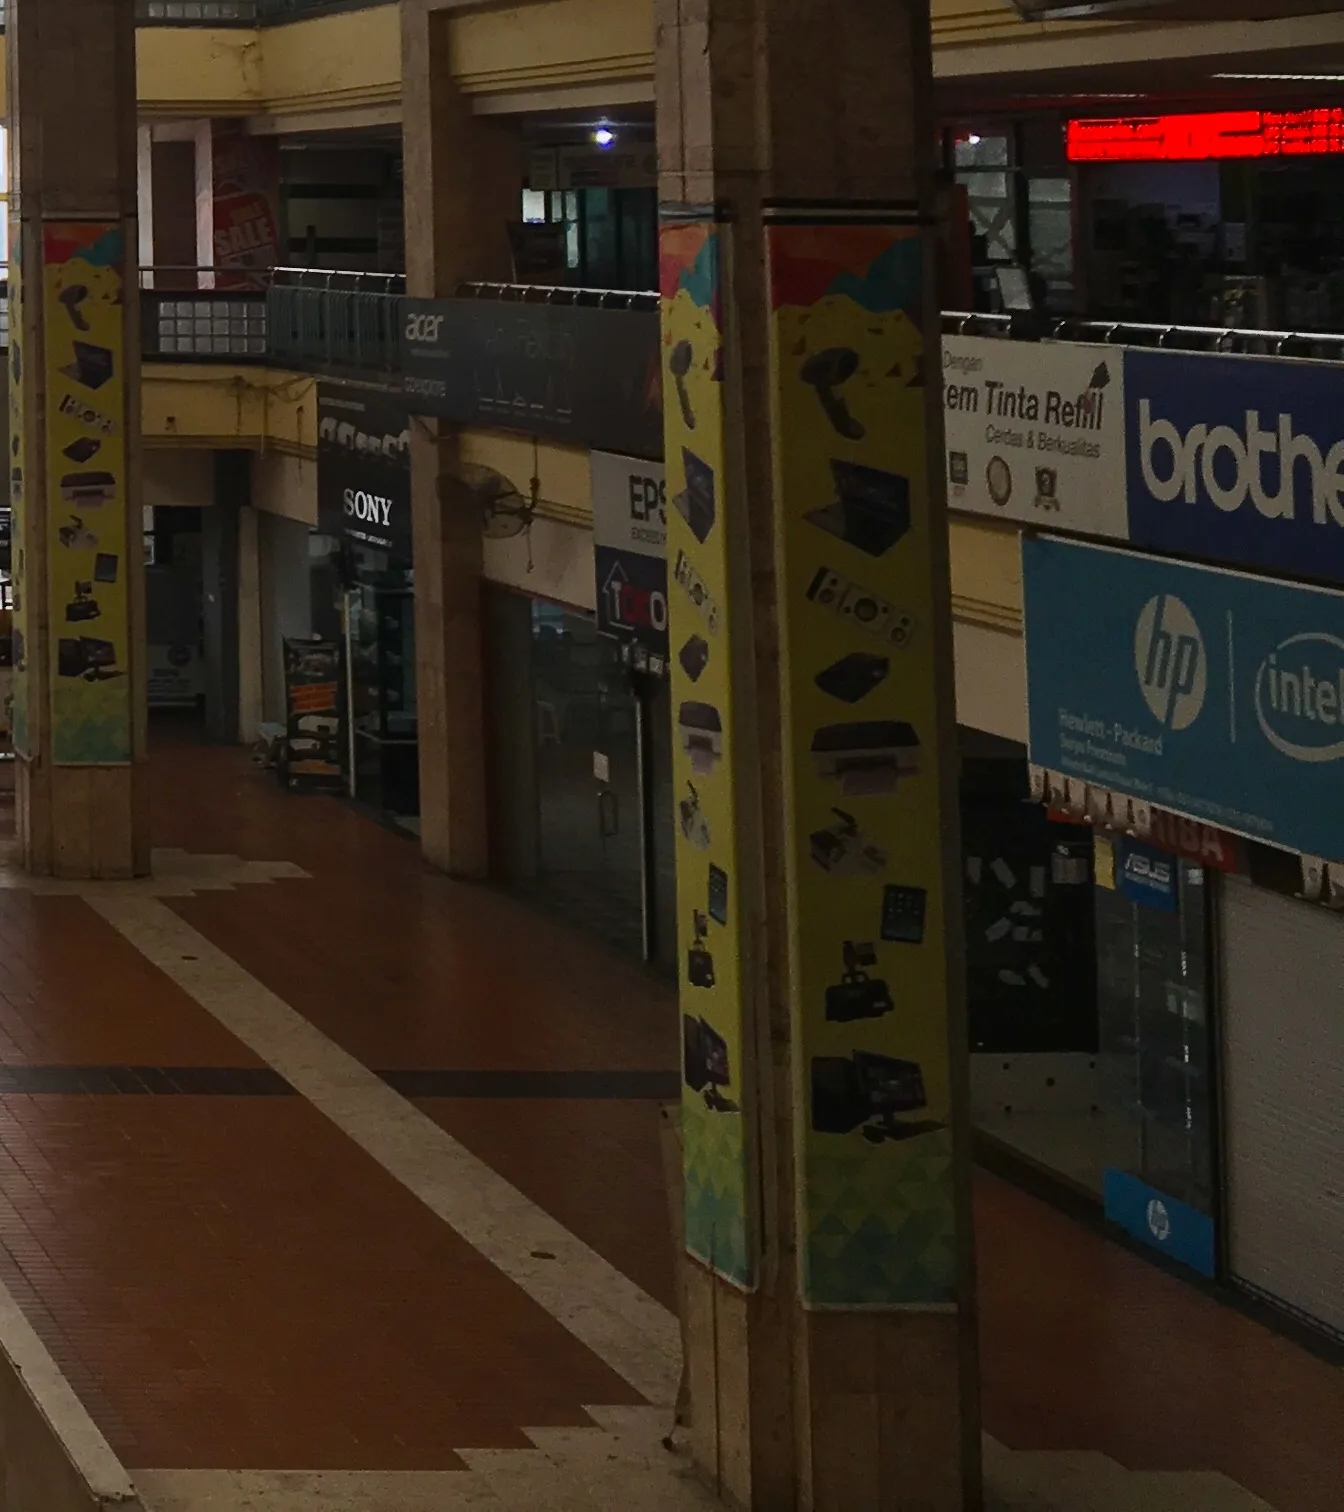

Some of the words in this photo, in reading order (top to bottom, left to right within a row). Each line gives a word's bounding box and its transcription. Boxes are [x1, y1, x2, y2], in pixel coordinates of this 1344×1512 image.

[405, 312, 443, 342] acer
[985, 380, 1039, 421] Tinta
[1045, 391, 1104, 431] Refill
[986, 424, 1023, 448] Cerdas
[343, 487, 393, 527] SONY
[1137, 594, 1204, 730] hp
[1114, 721, 1163, 756] Packard
[1124, 852, 1171, 884] ASUS
[1146, 1199, 1170, 1241] hp
